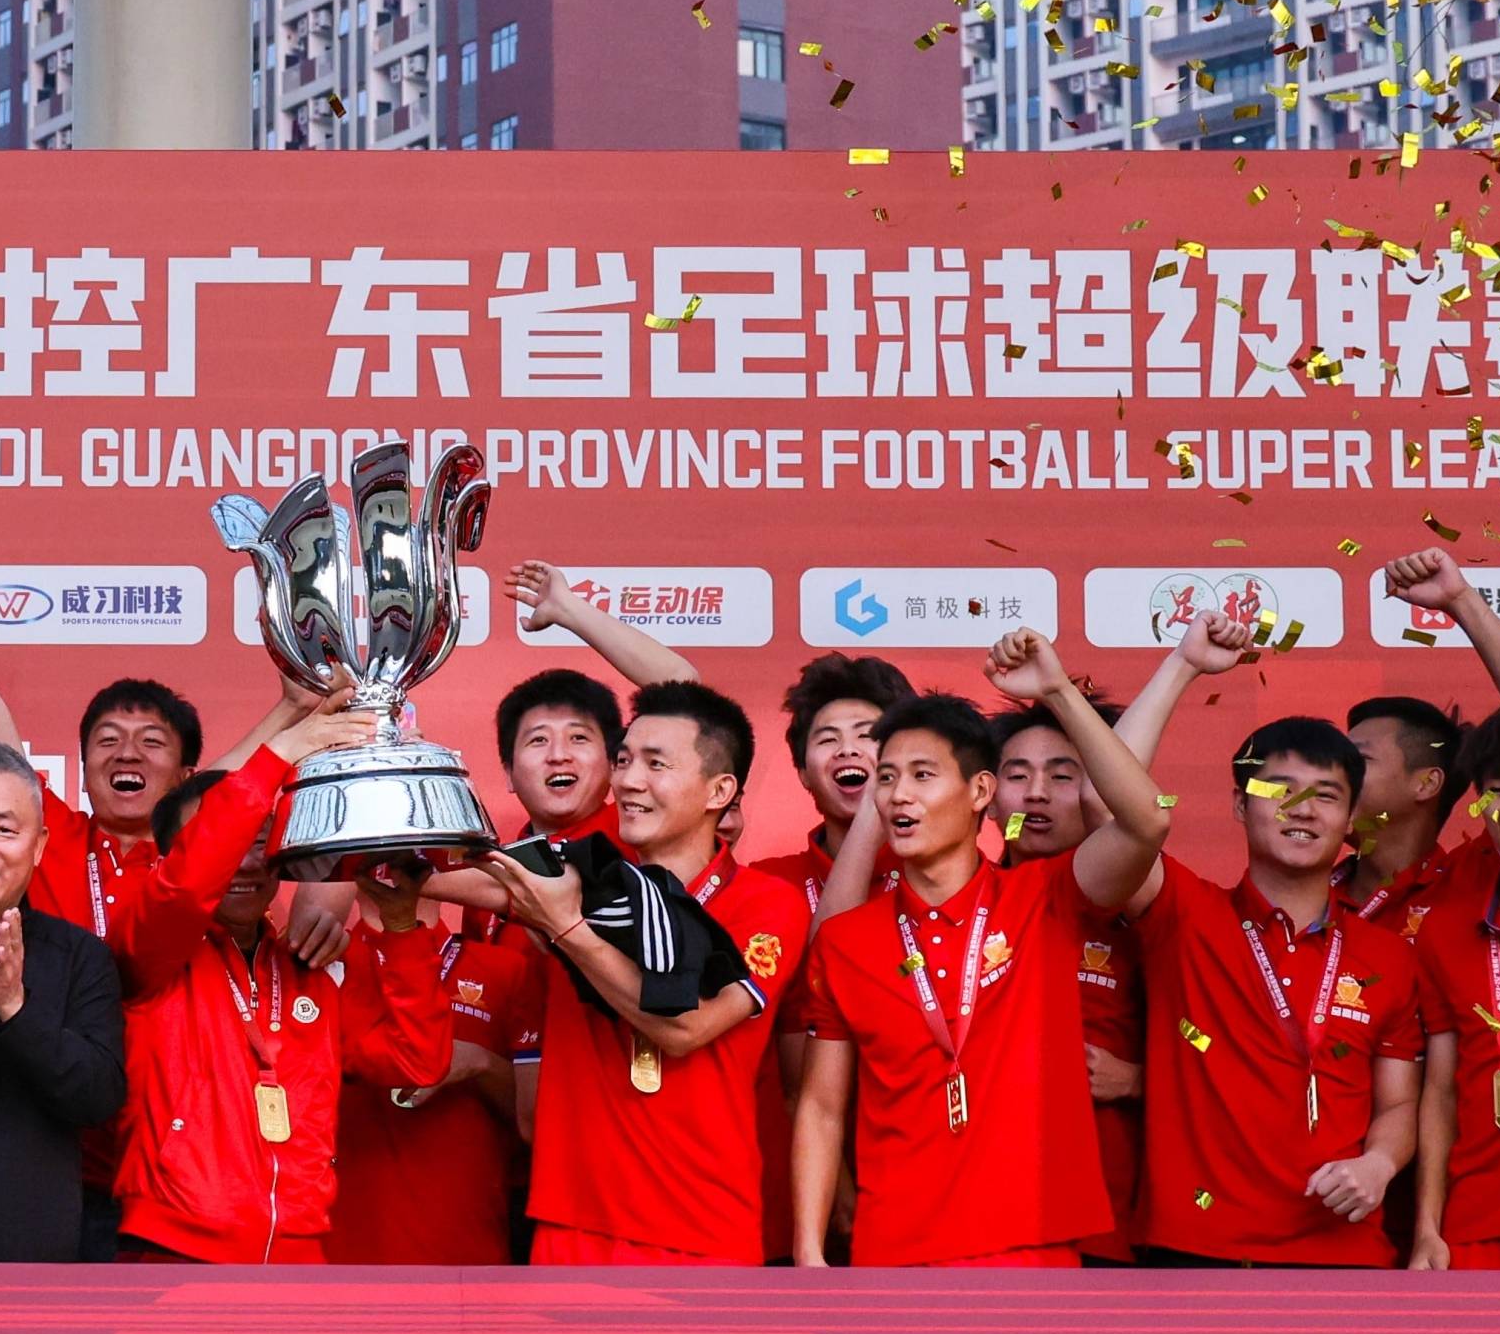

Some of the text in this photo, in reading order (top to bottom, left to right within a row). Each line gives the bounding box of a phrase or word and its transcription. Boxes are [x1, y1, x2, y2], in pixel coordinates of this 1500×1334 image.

[486, 428, 804, 489] PROVINCE
[822, 429, 1149, 489] FOOTBALL
[1167, 429, 1372, 489] SUPER
[62, 585, 183, 614] 威习科技
[619, 585, 724, 615] 运动保
[62, 618, 182, 626] SPORTS PROTECTION SPECIALIST
